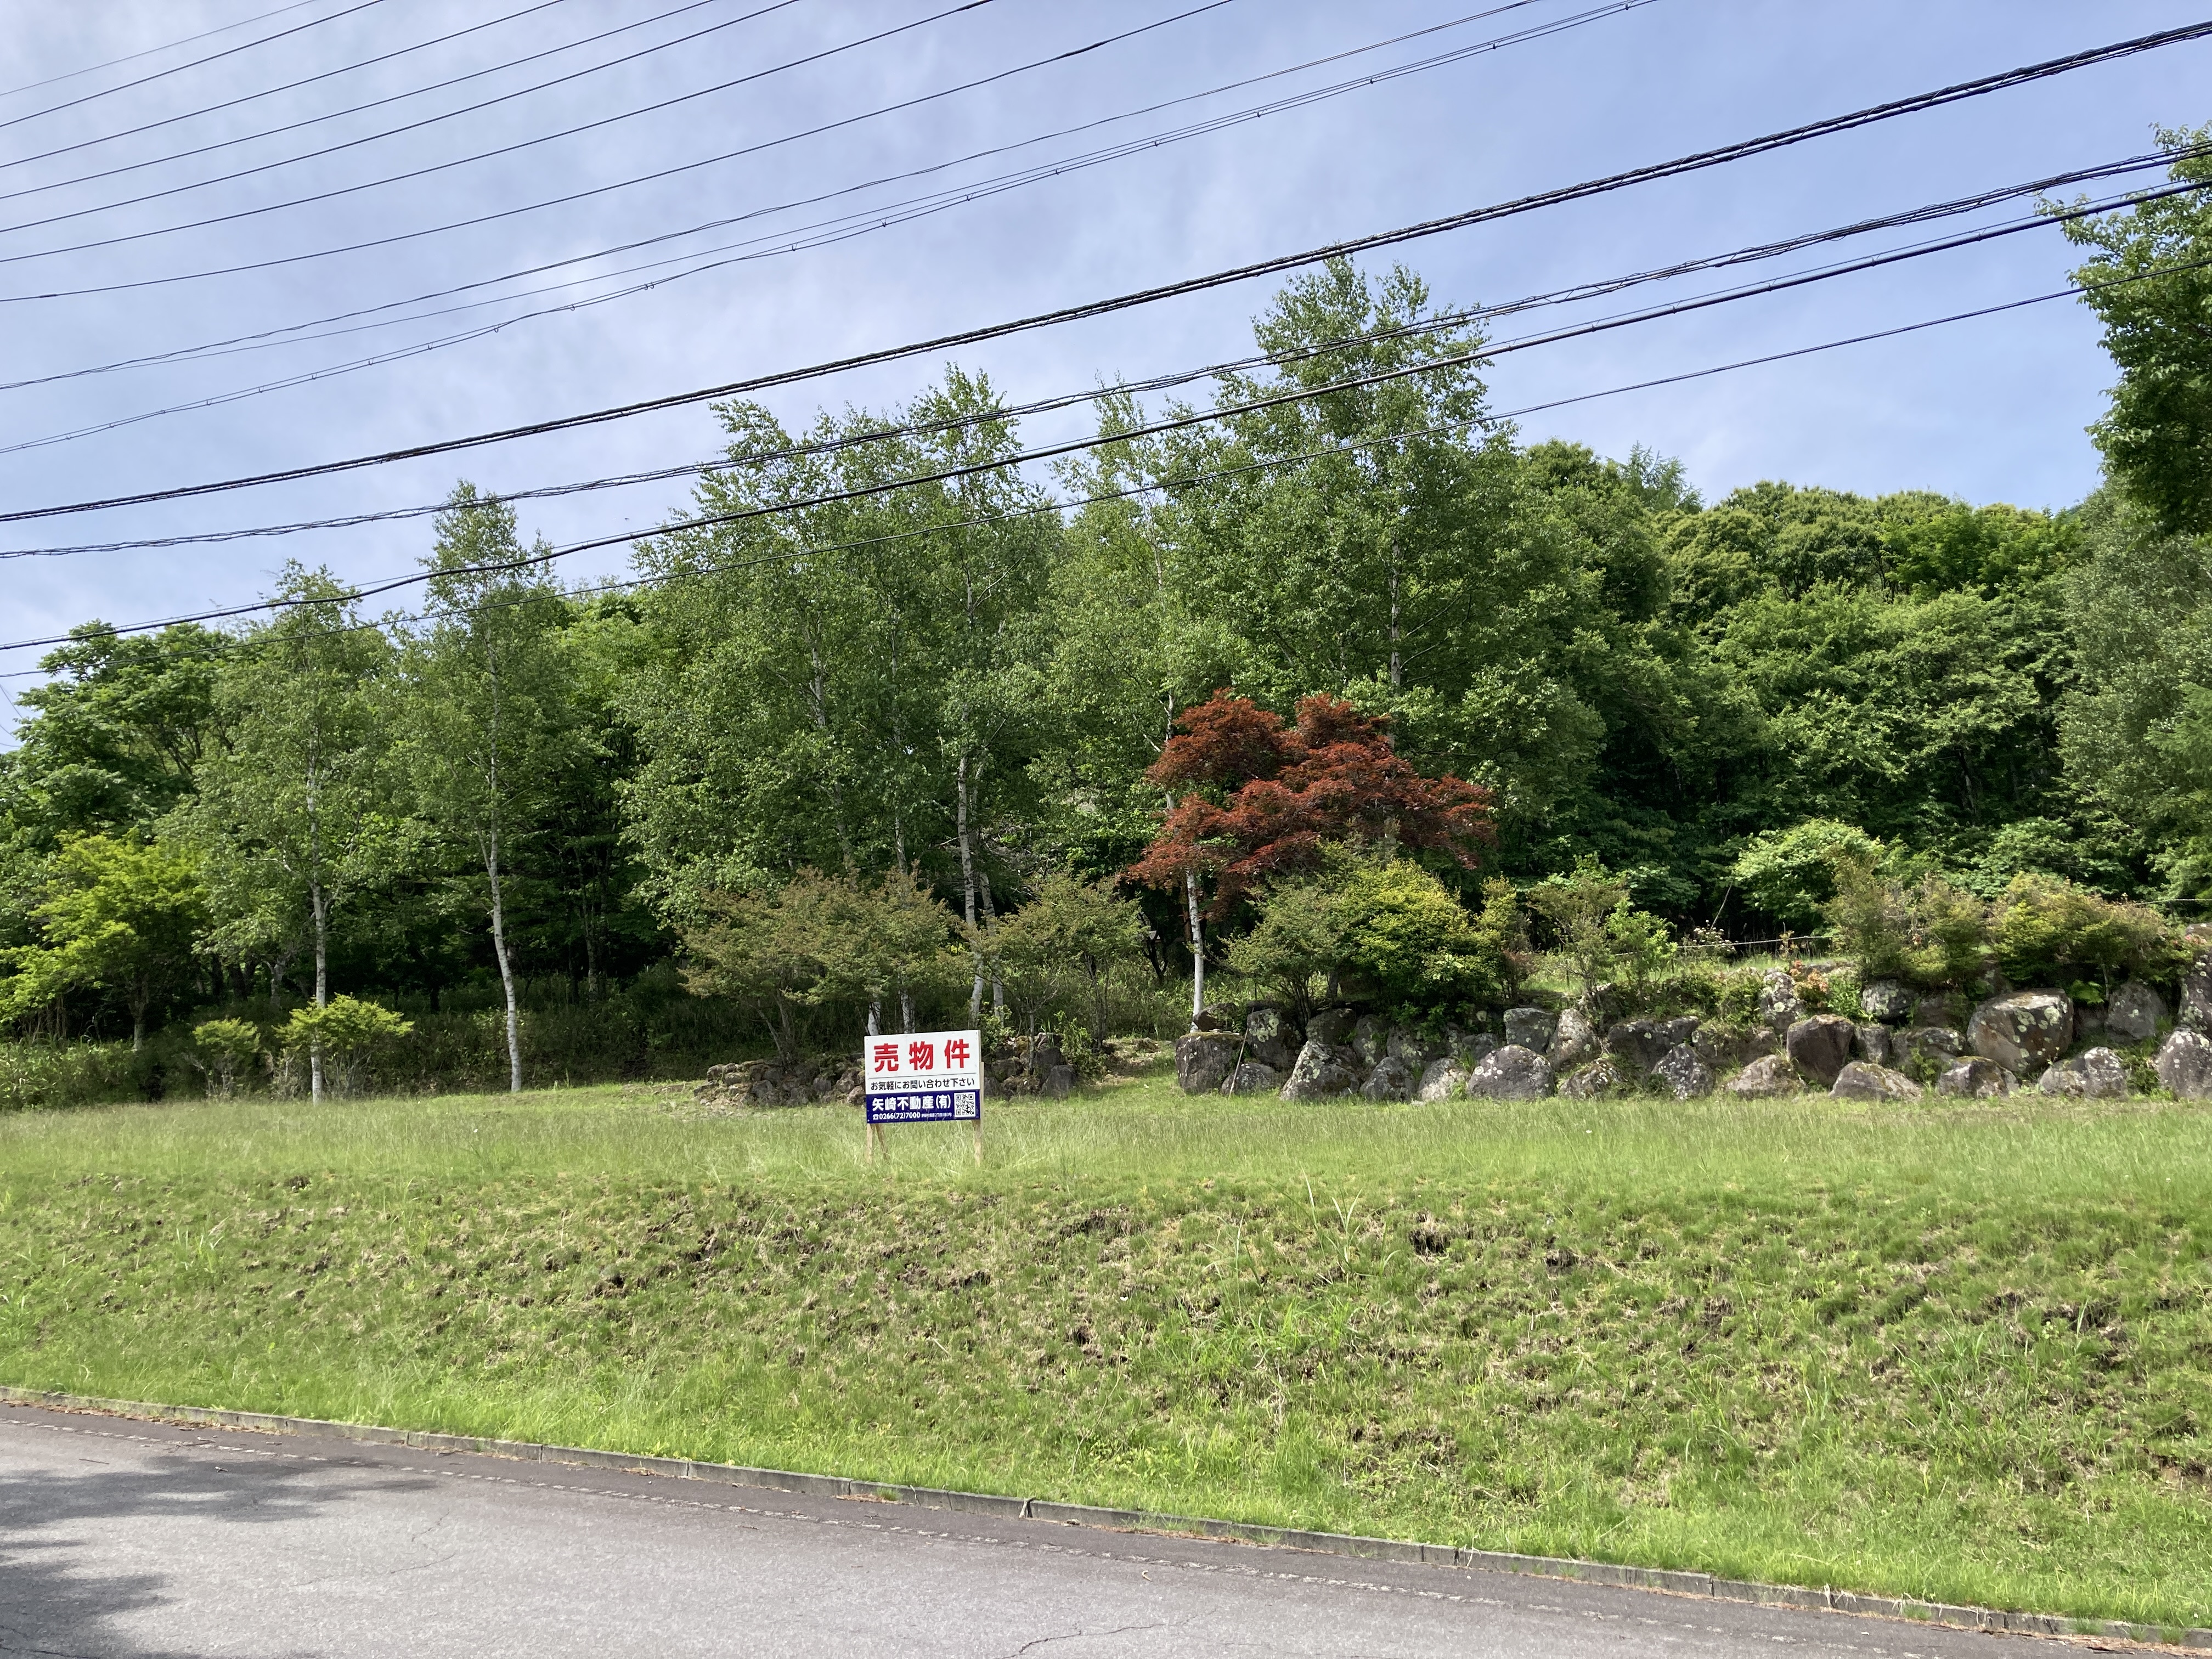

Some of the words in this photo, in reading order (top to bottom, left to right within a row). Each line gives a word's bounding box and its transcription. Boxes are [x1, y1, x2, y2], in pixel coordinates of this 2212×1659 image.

[874, 1039, 969, 1073] 売物件
[871, 1078, 974, 1091] お気軽にお問い合わせ下さい
